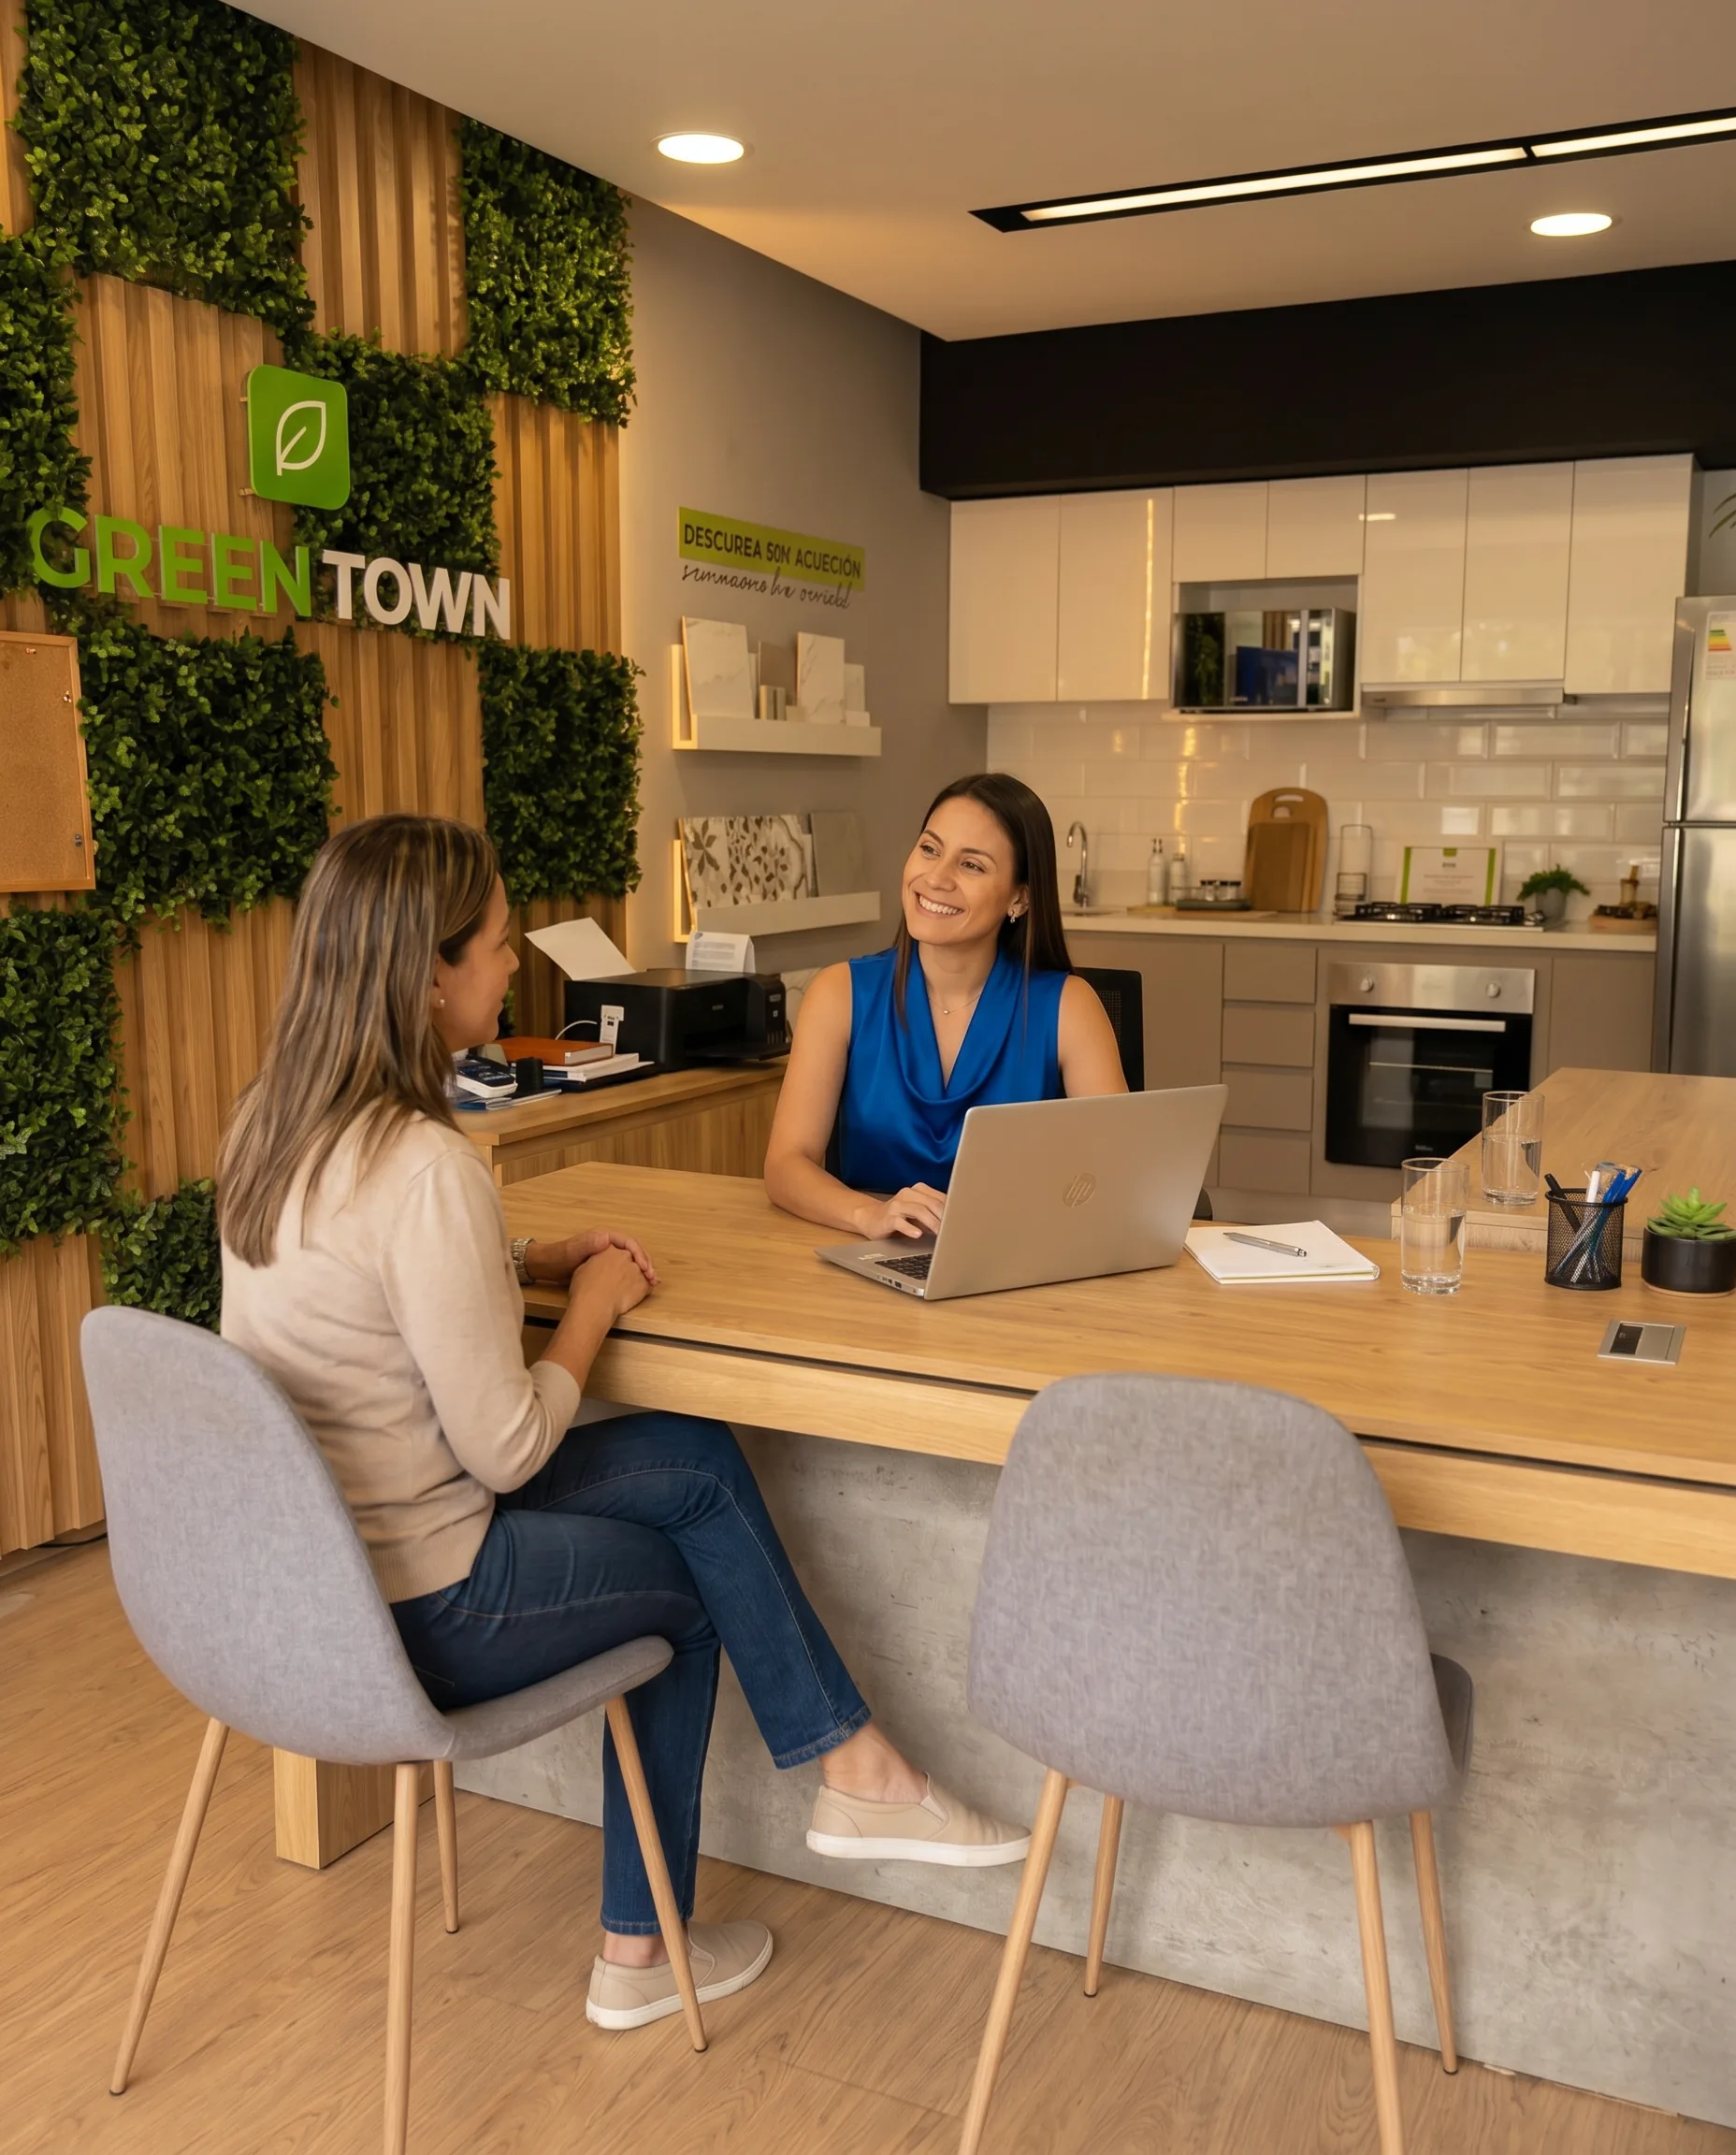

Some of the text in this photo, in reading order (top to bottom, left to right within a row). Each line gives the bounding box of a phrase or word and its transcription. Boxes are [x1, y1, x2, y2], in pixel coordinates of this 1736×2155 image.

[26, 505, 511, 640] GREEN TOWN
[685, 523, 762, 560] DESCUREA
